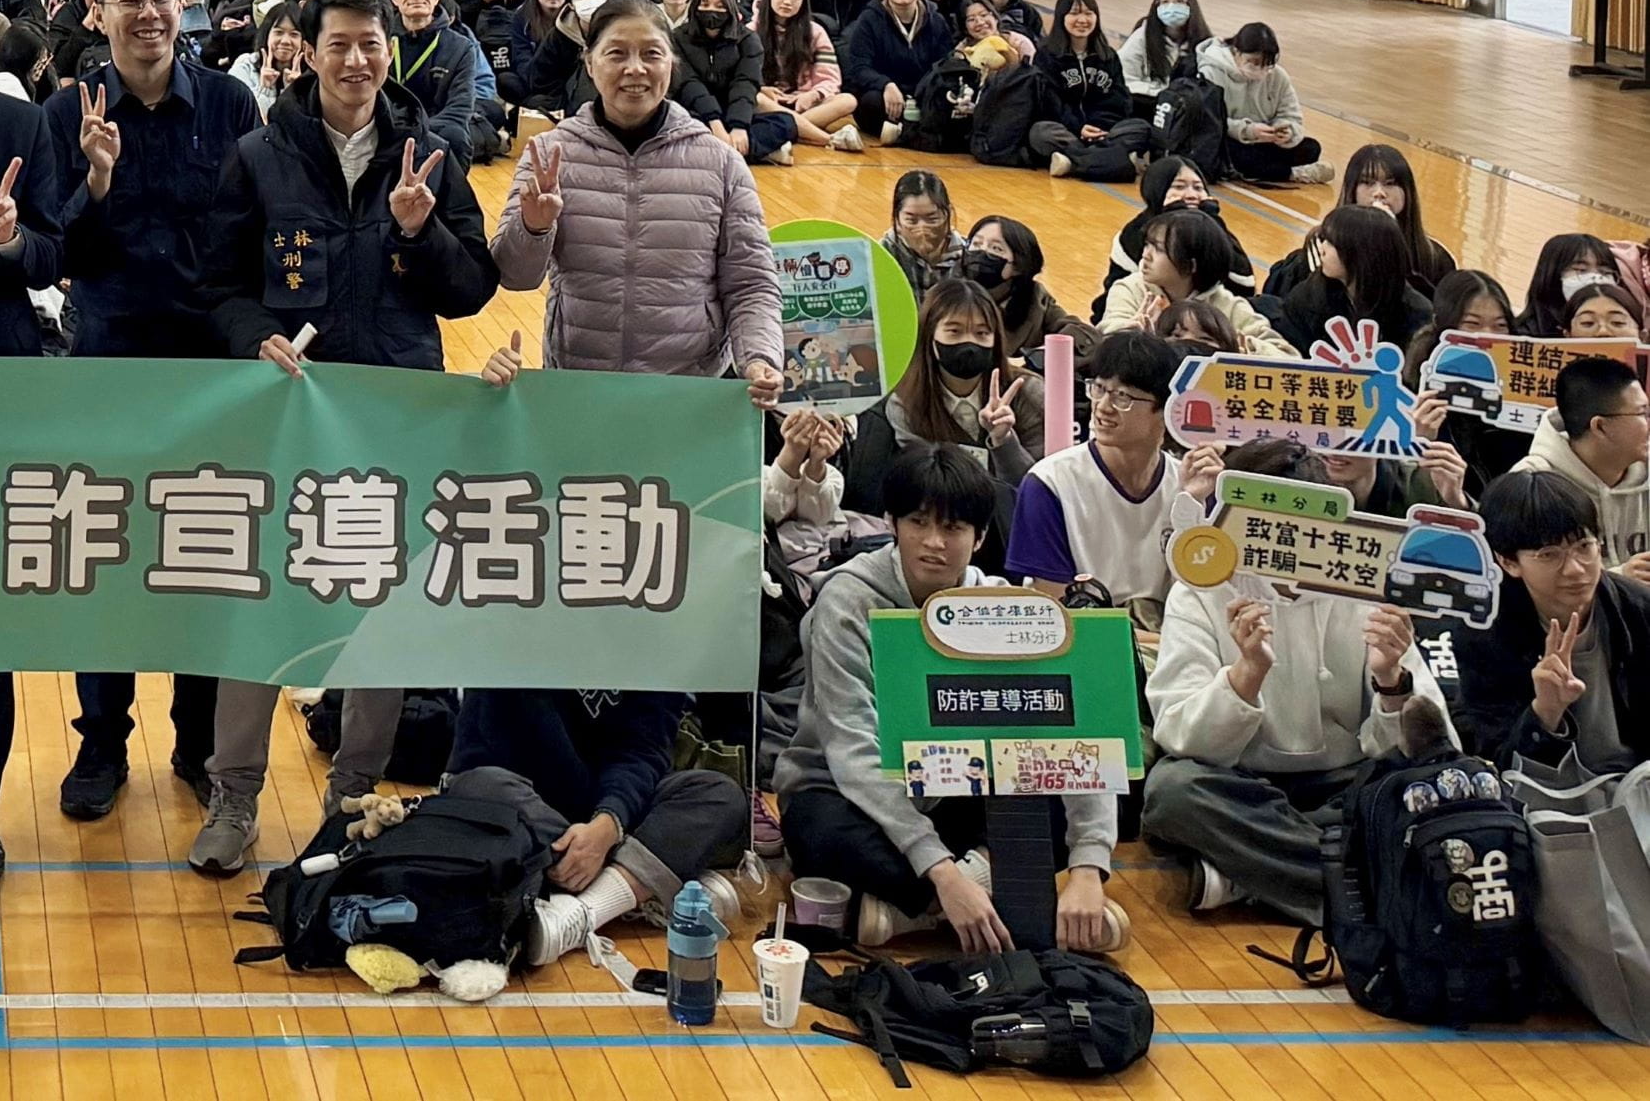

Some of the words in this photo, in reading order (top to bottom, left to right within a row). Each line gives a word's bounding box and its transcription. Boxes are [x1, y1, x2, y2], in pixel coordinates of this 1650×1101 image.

[273, 230, 313, 248] 士林
[1508, 341, 1608, 370] 連結
[1225, 370, 1359, 401] 路口等幾秒
[1225, 395, 1358, 428] 安全最首要
[1230, 486, 1339, 517] 士林分局
[1246, 516, 1382, 559] 致富十年功
[1242, 546, 1379, 589] 詐騙一次空
[1005, 630, 1058, 645] 士林分行
[937, 688, 1066, 713] 防詐宣導活動
[1034, 772, 1067, 790] 165
